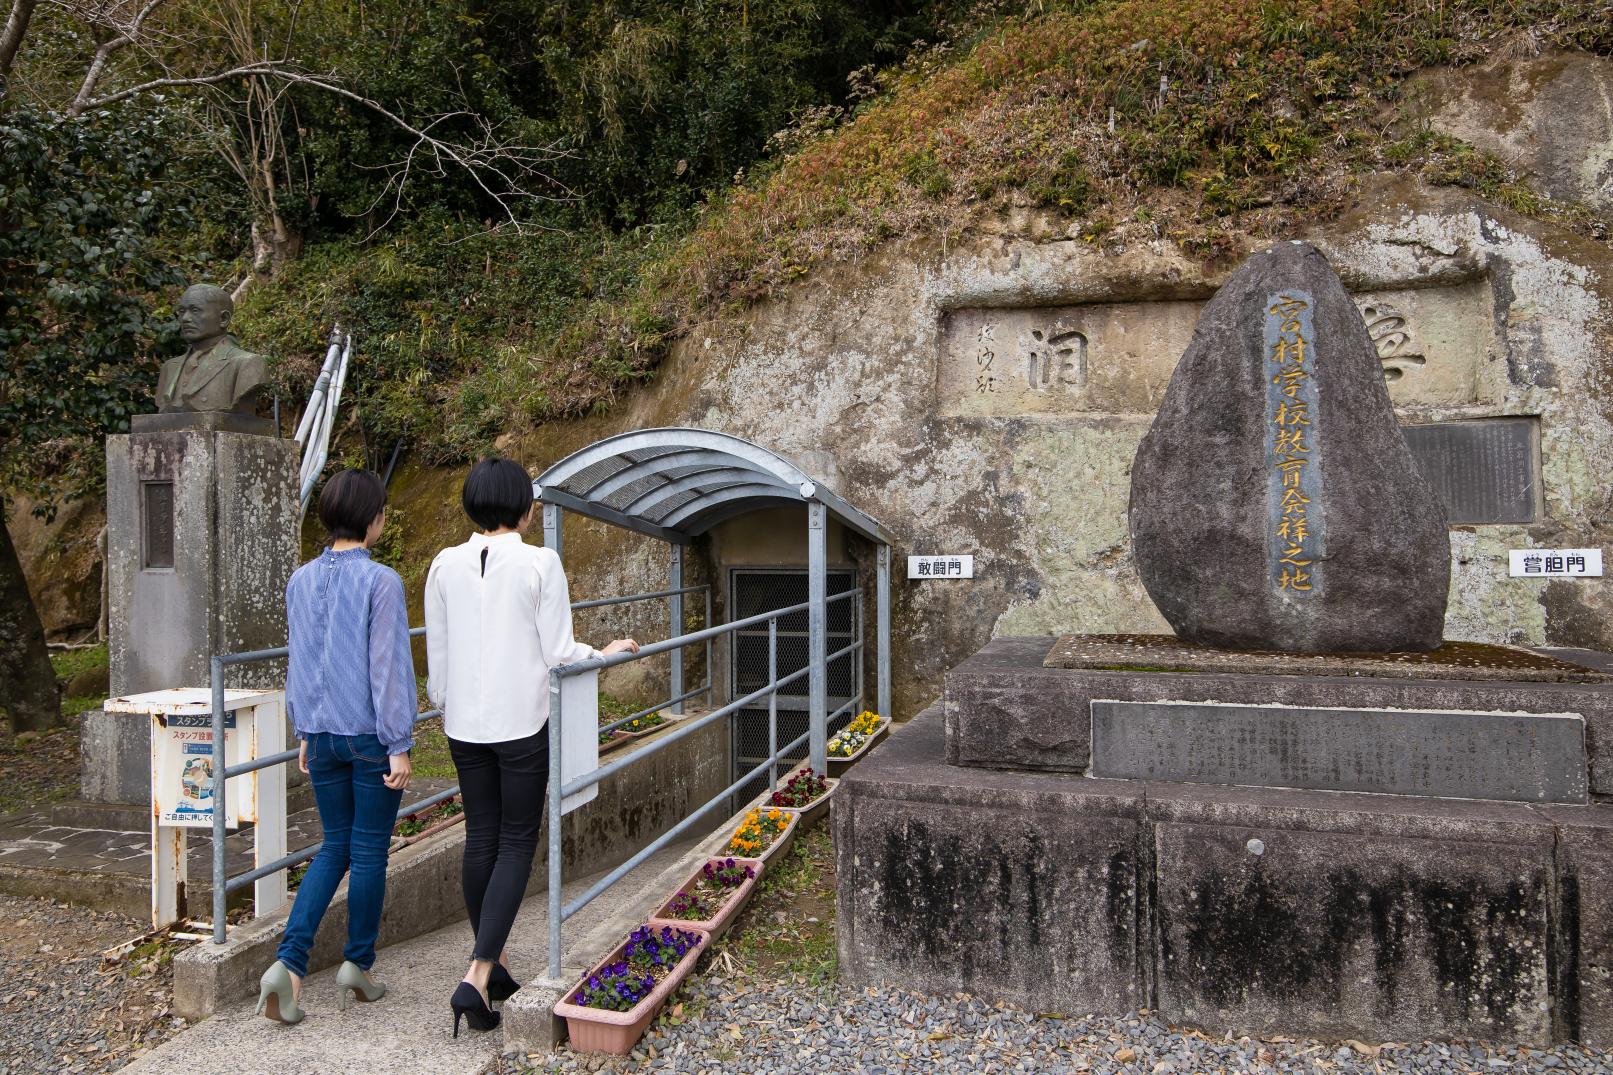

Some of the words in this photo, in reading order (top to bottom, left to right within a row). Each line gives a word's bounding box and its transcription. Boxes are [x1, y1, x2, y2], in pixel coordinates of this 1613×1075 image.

[1269, 295, 1313, 591] 宮村学校教育発祥之地
[918, 562, 961, 575] 敢闘門
[164, 813, 231, 822] ご自由に押してくい
